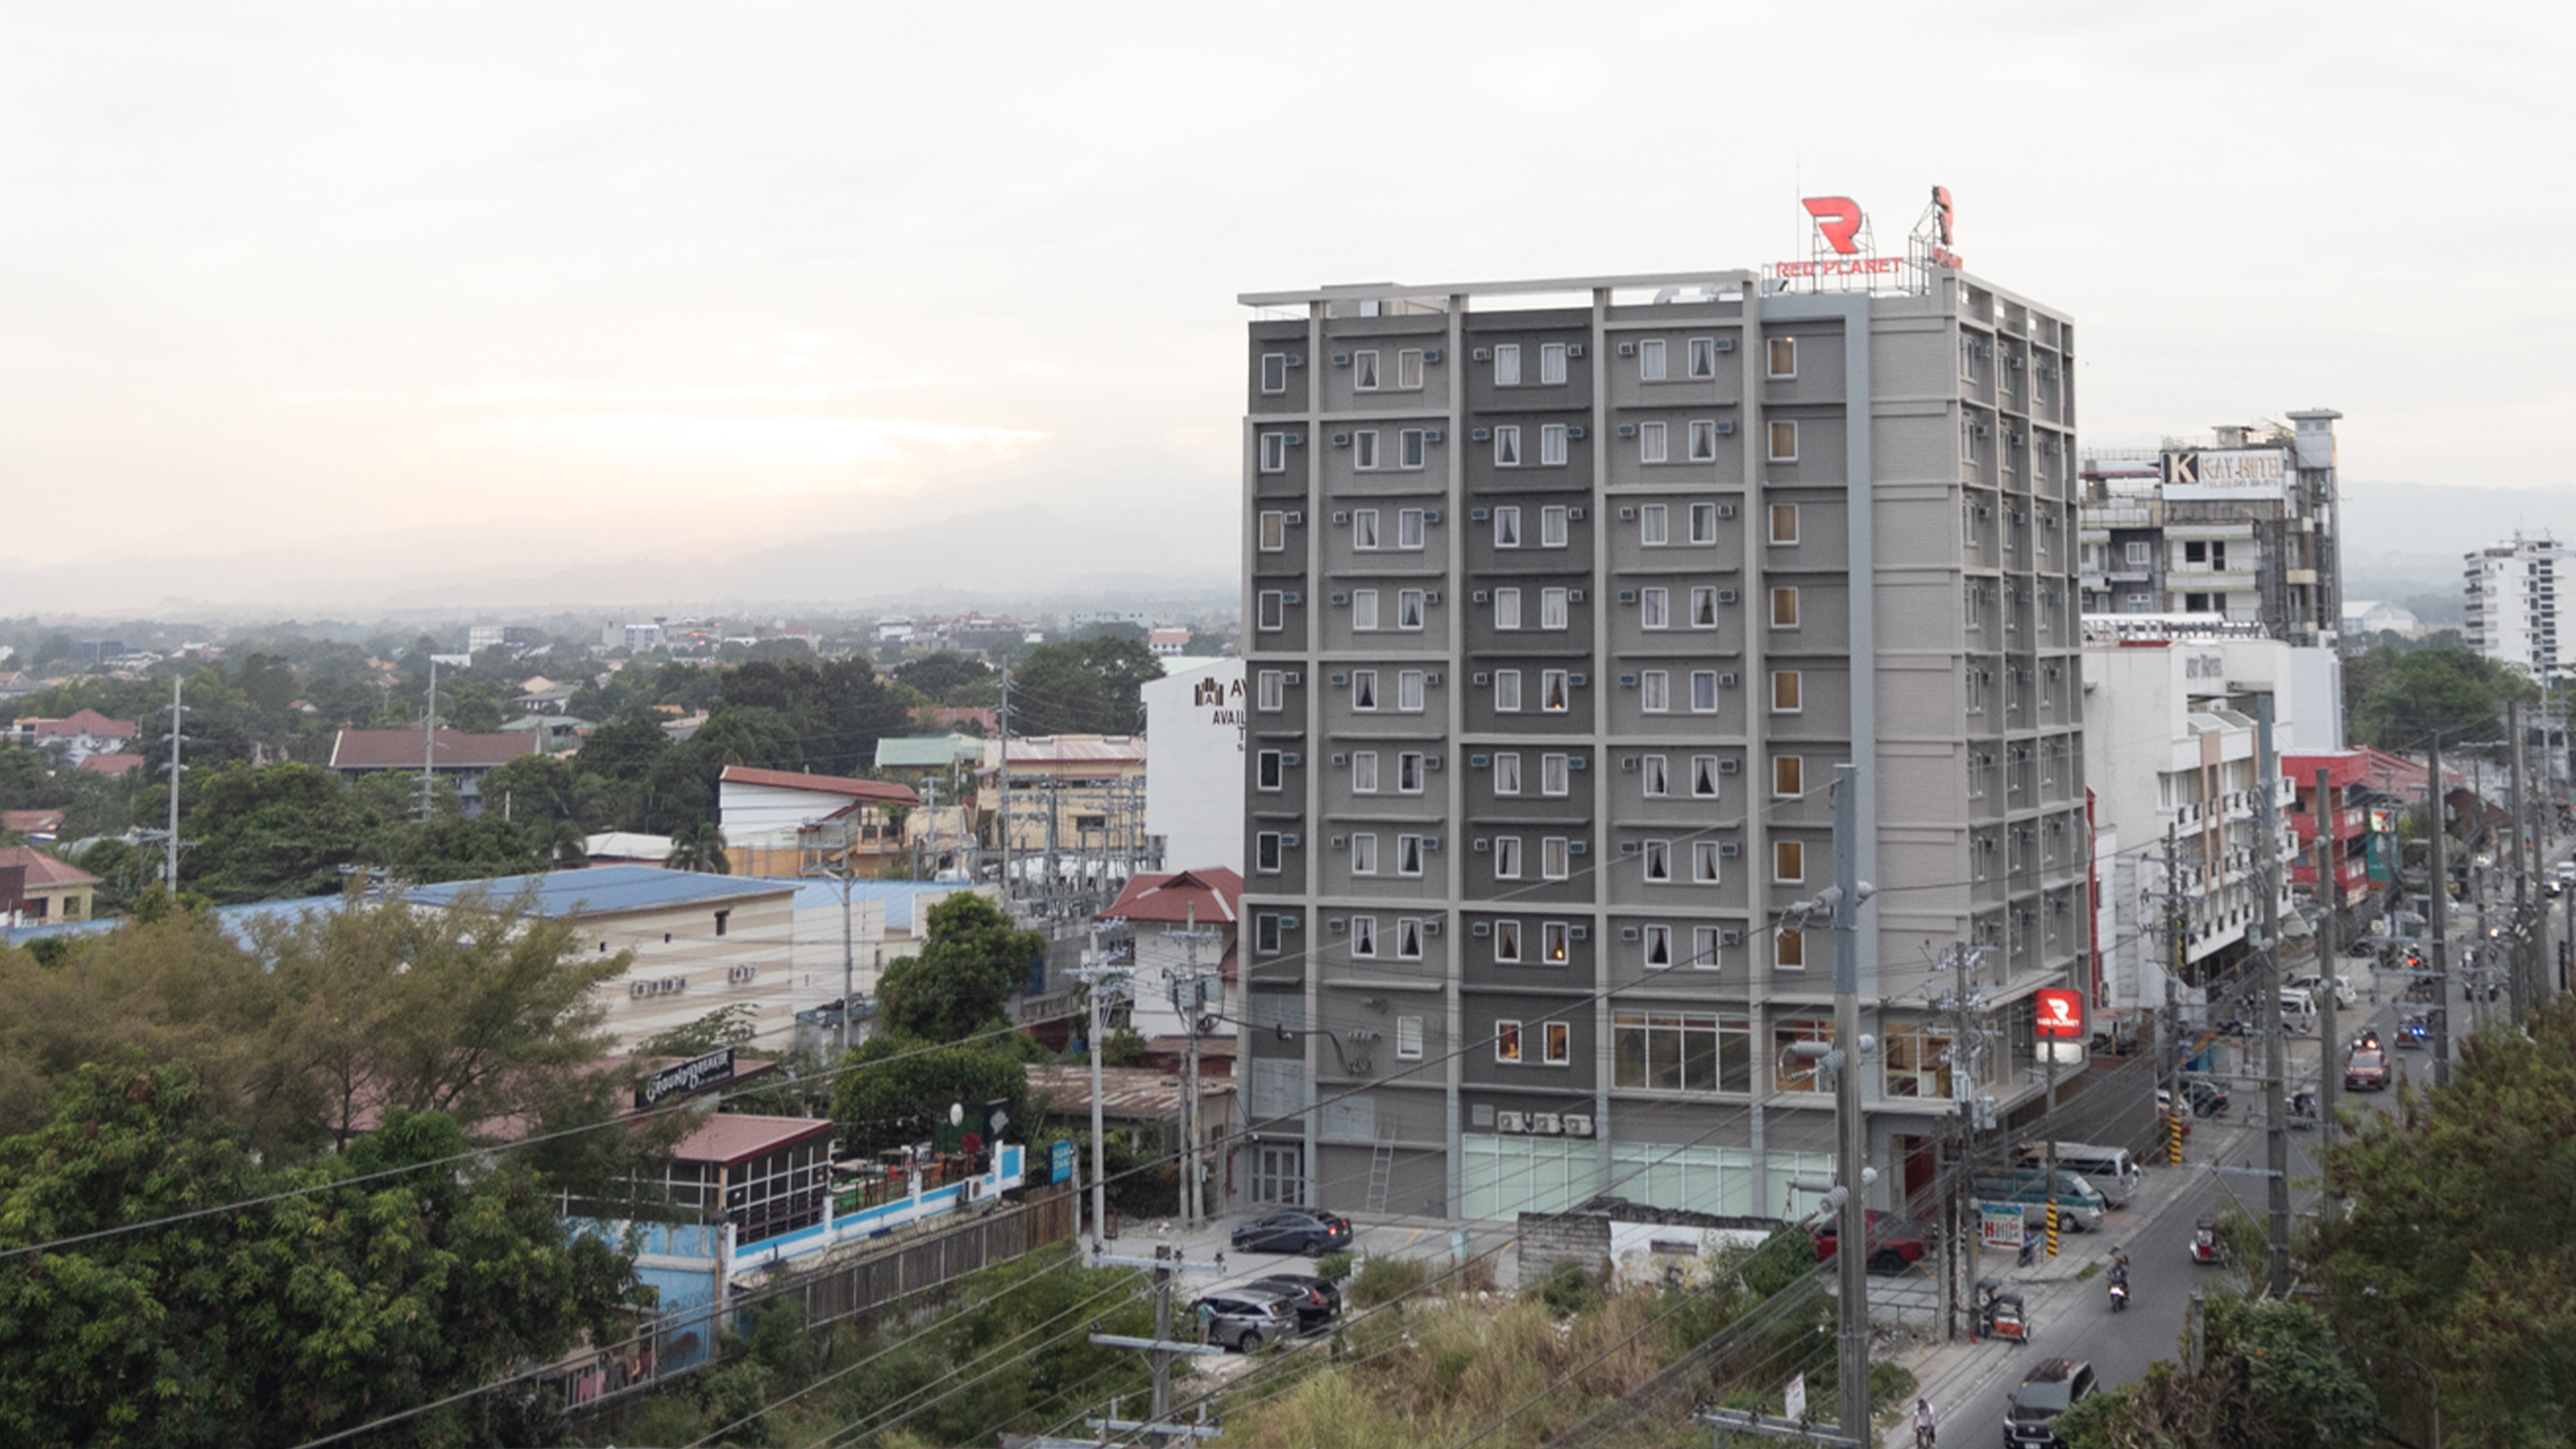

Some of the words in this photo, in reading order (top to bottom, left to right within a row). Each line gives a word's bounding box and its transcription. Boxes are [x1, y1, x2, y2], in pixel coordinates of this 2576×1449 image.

[1802, 197, 1861, 254] R
[1775, 261, 1815, 277] RED
[1823, 258, 1902, 275] PLANET
[2169, 453, 2196, 483] K
[2200, 458, 2233, 479] KAY
[2240, 456, 2283, 478] HOTEL
